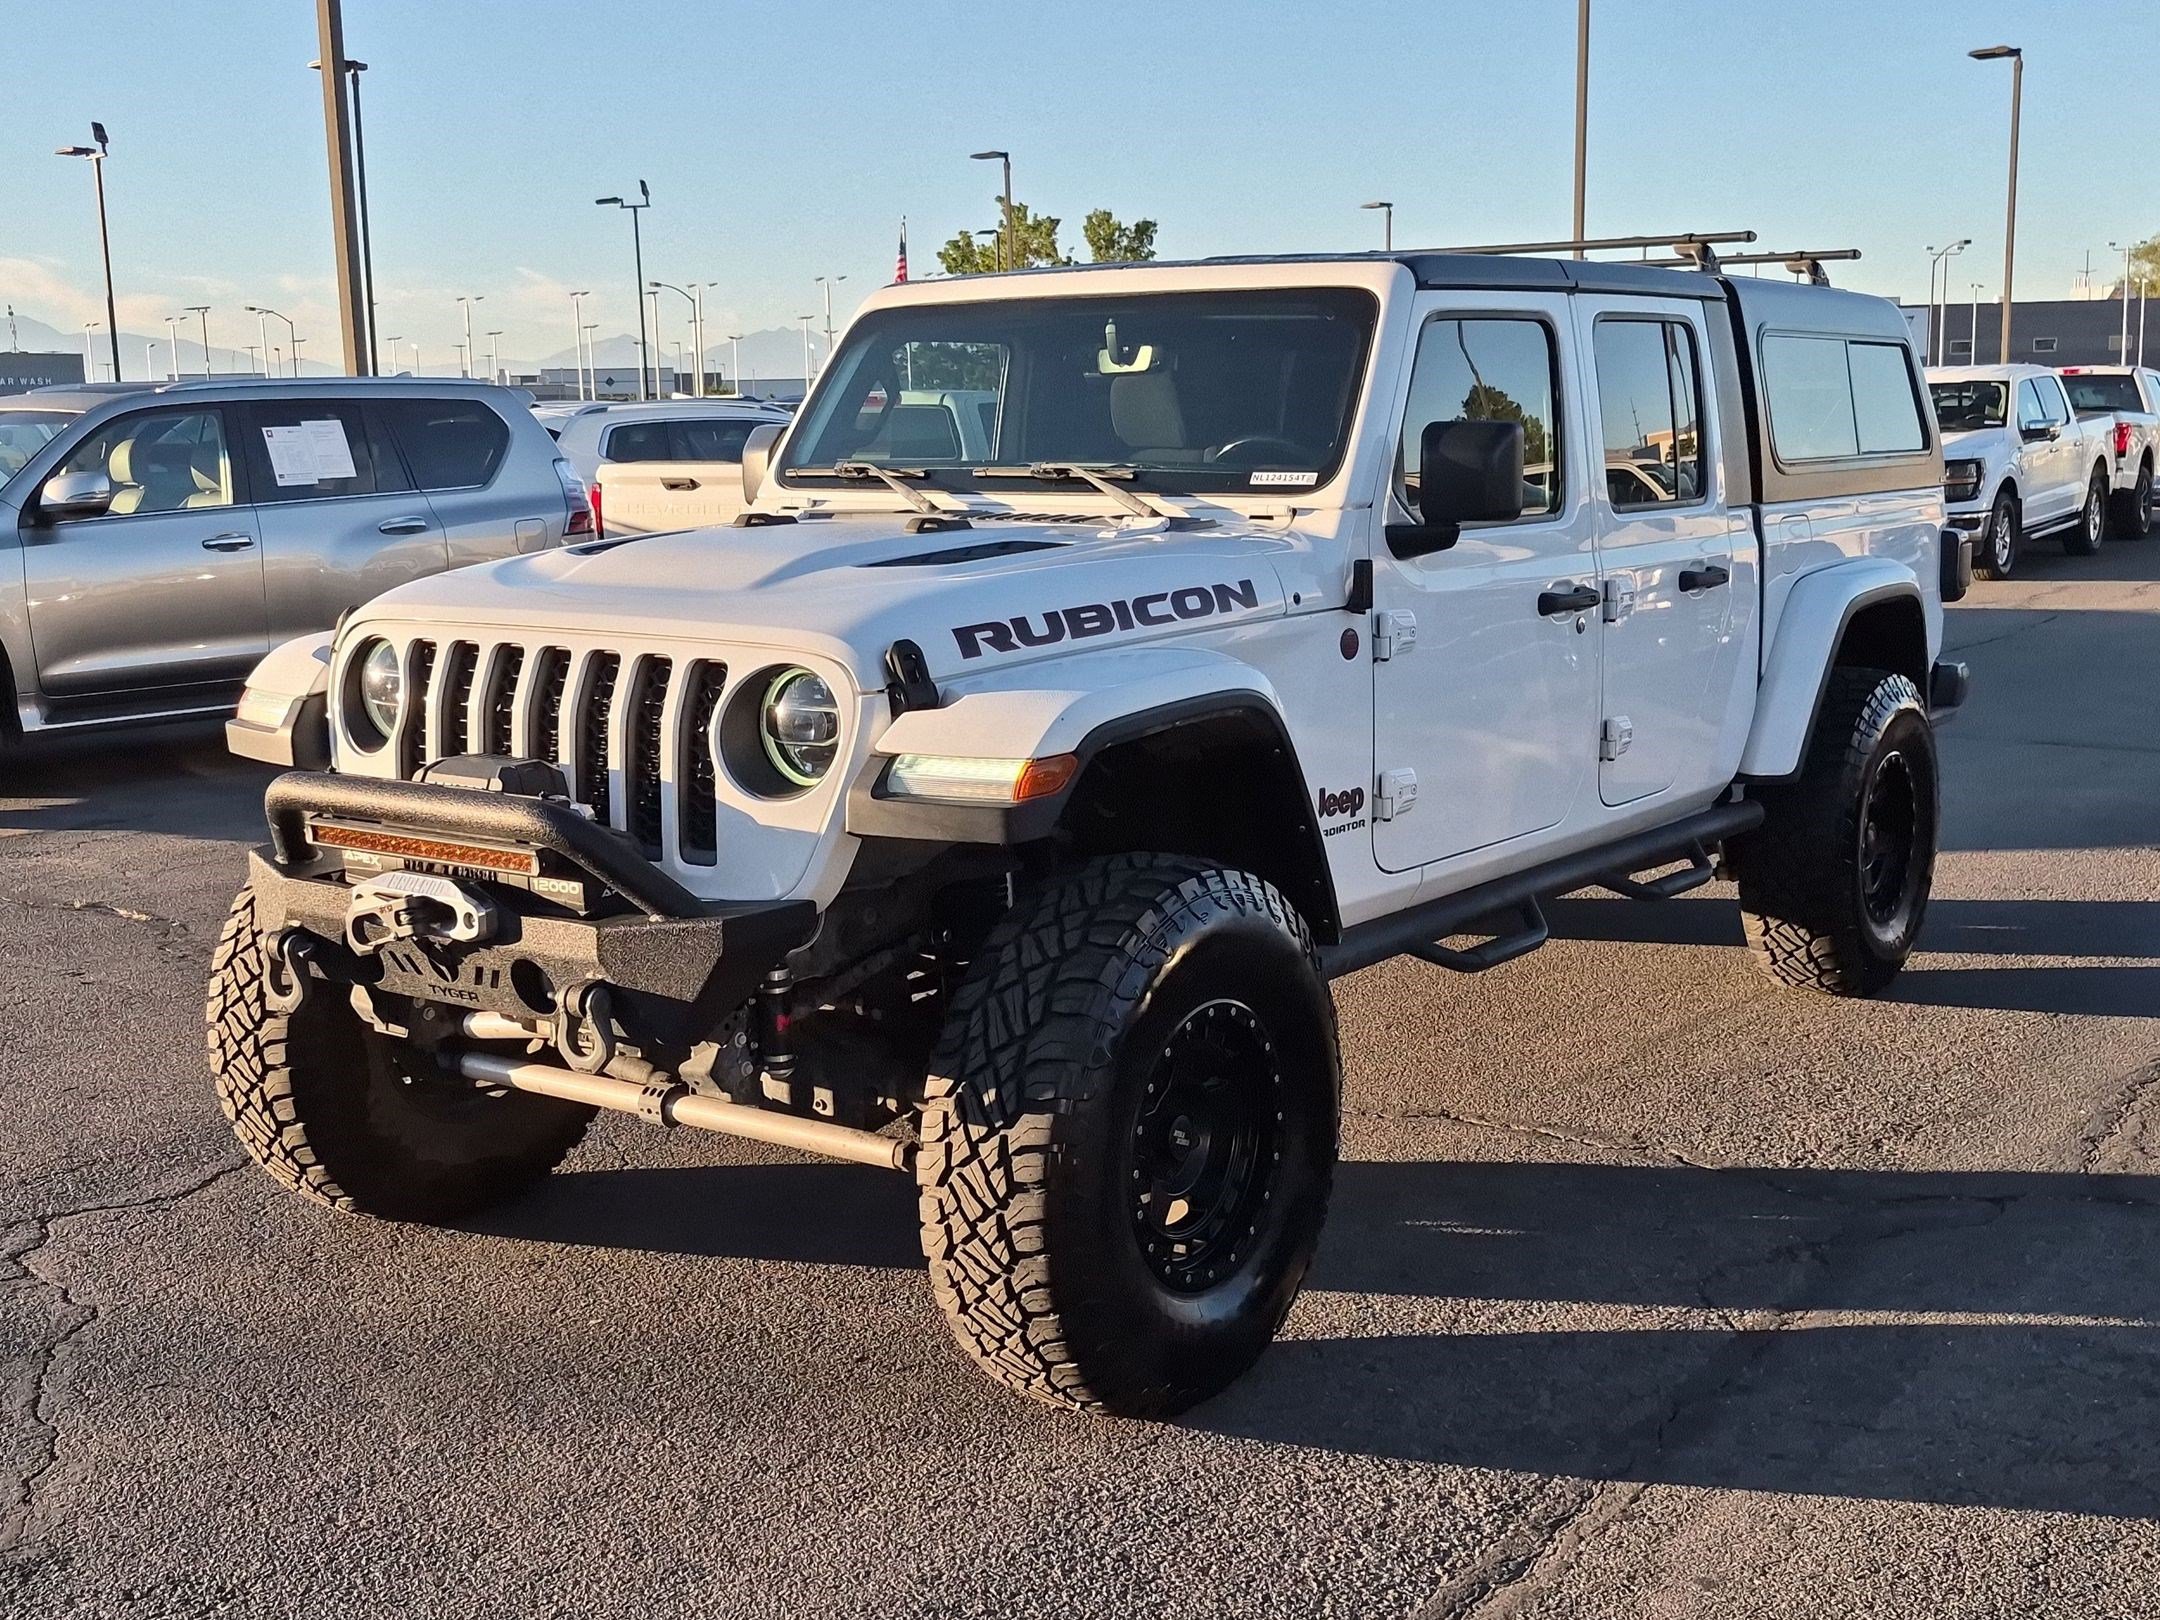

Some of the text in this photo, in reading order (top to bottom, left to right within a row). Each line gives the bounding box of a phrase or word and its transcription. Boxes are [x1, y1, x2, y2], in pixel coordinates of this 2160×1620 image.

[0, 377, 52, 385] AR WASH
[951, 579, 1259, 660] RUBICON
[1319, 787, 1364, 818] Jeep
[1323, 819, 1366, 837] ADIATOR
[344, 850, 381, 865] APEX
[531, 879, 580, 895] 12000
[428, 984, 480, 1002] TYGER
